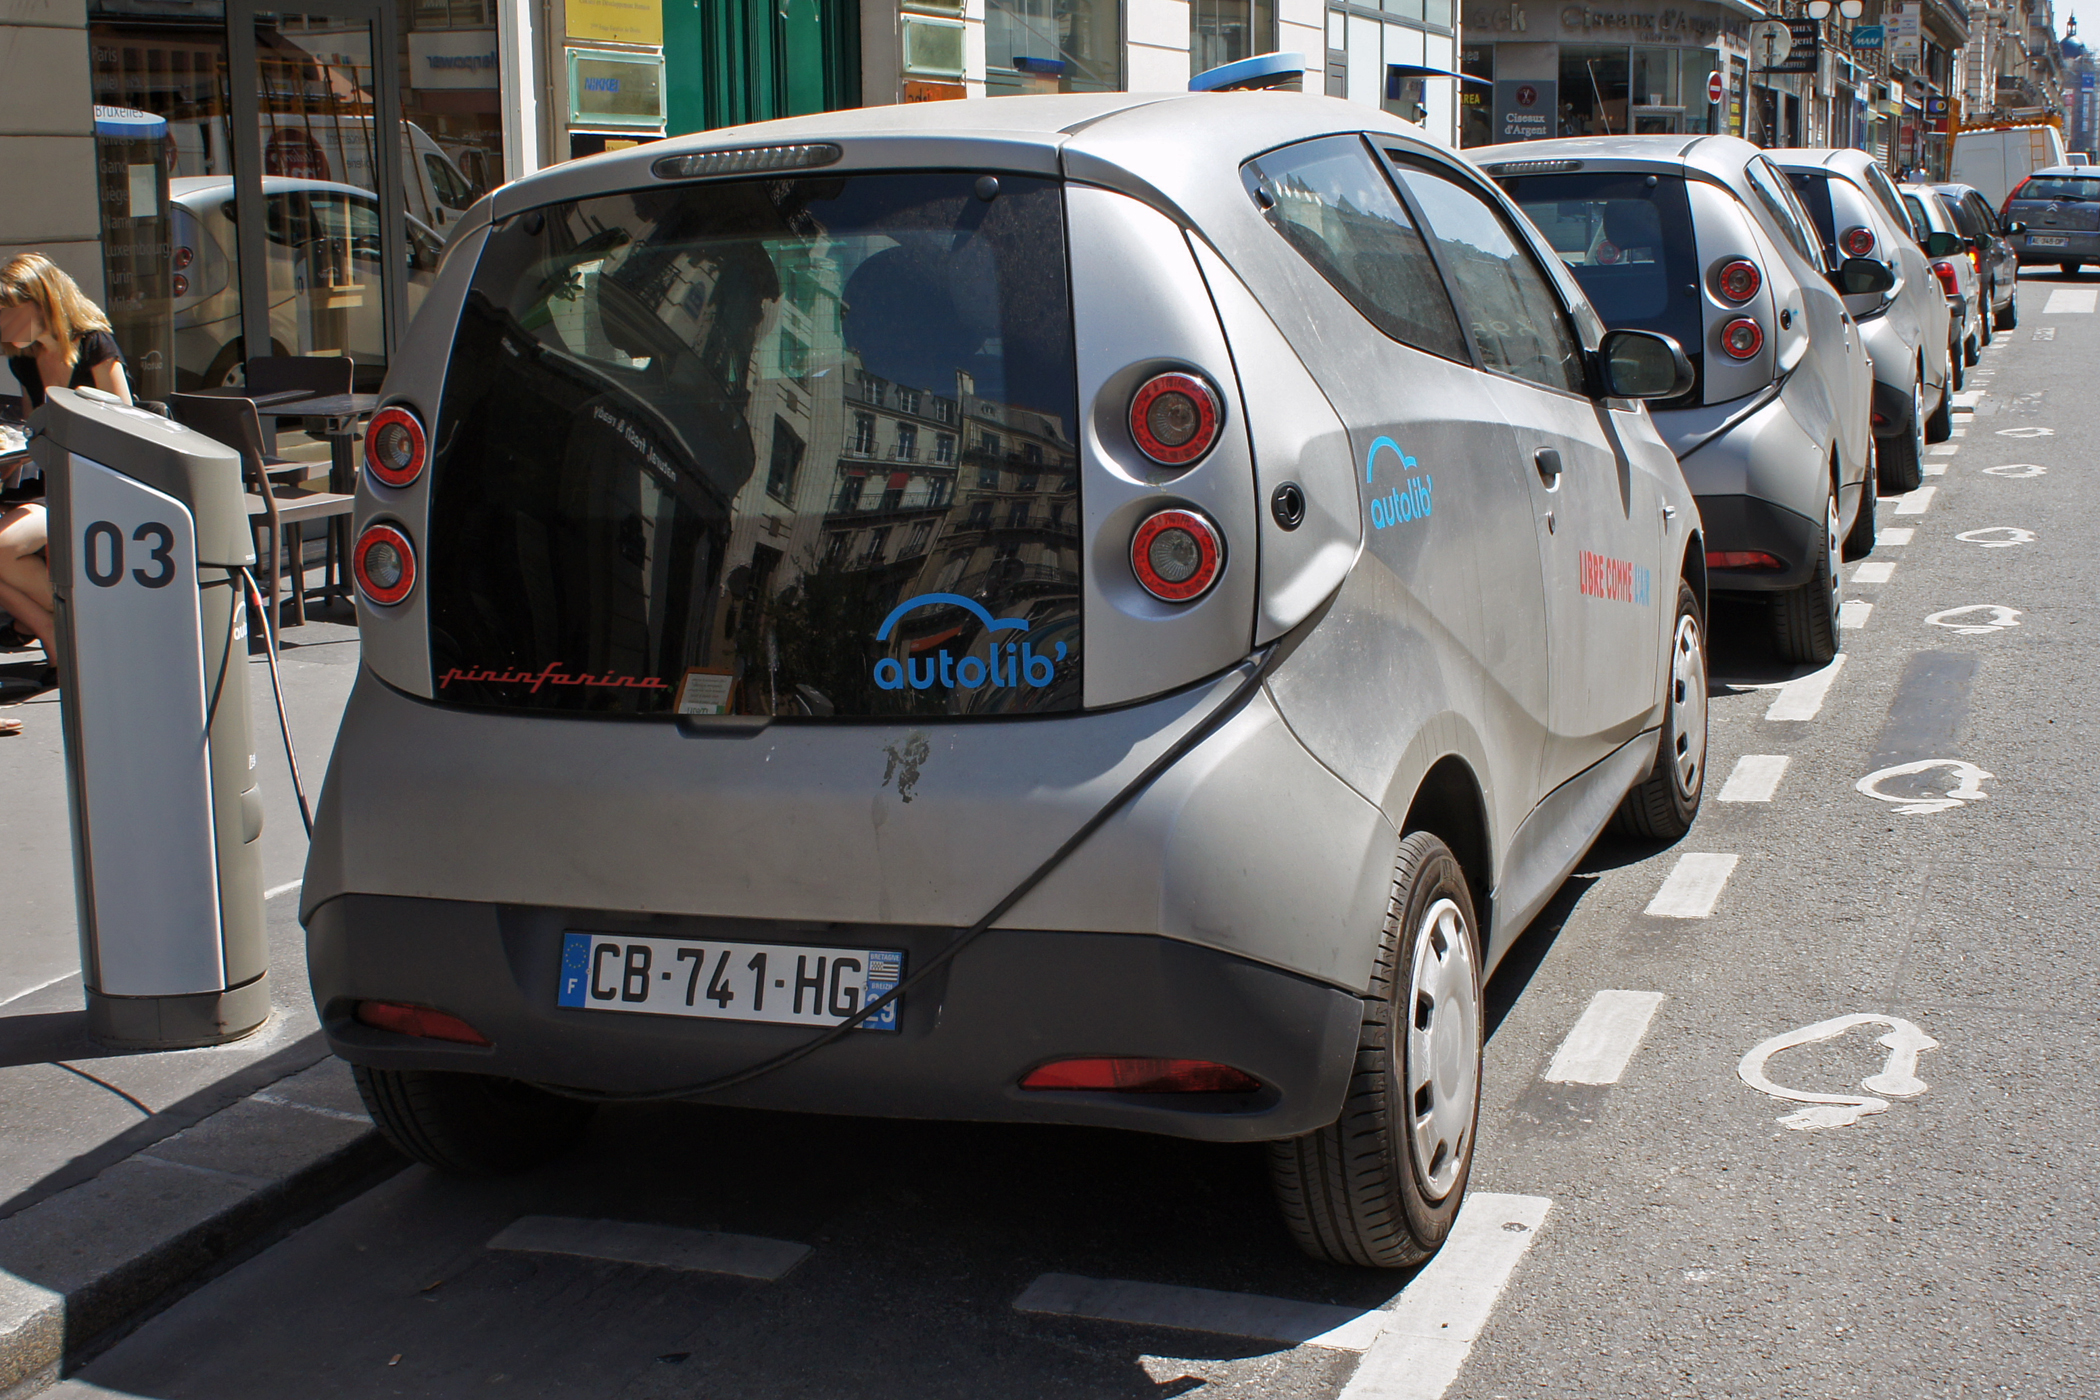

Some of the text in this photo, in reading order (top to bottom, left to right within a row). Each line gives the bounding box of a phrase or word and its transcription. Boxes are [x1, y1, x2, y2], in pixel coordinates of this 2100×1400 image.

[1561, 5, 1653, 31] Ciseaux
[92, 45, 118, 62] Paris
[584, 77, 620, 93] NIKKEI
[94, 103, 144, 118] Bruxelles
[1505, 113, 1546, 123] Ciseaux
[1504, 125, 1547, 136] d'Argent
[100, 185, 129, 206] Liège
[104, 242, 170, 258] Luxembourg
[107, 268, 133, 285] Turin
[1371, 474, 1433, 530] autolib'
[84, 520, 176, 588] 03
[1579, 550, 1605, 599] LIBRE
[1606, 557, 1634, 603] COMME
[873, 641, 1067, 690] autolib'
[439, 662, 669, 693] pininfarina
[870, 953, 900, 962] BRETAGNE
[567, 978, 578, 995] F
[591, 943, 862, 1018] CB-741-HG
[871, 982, 893, 990] BREIZH
